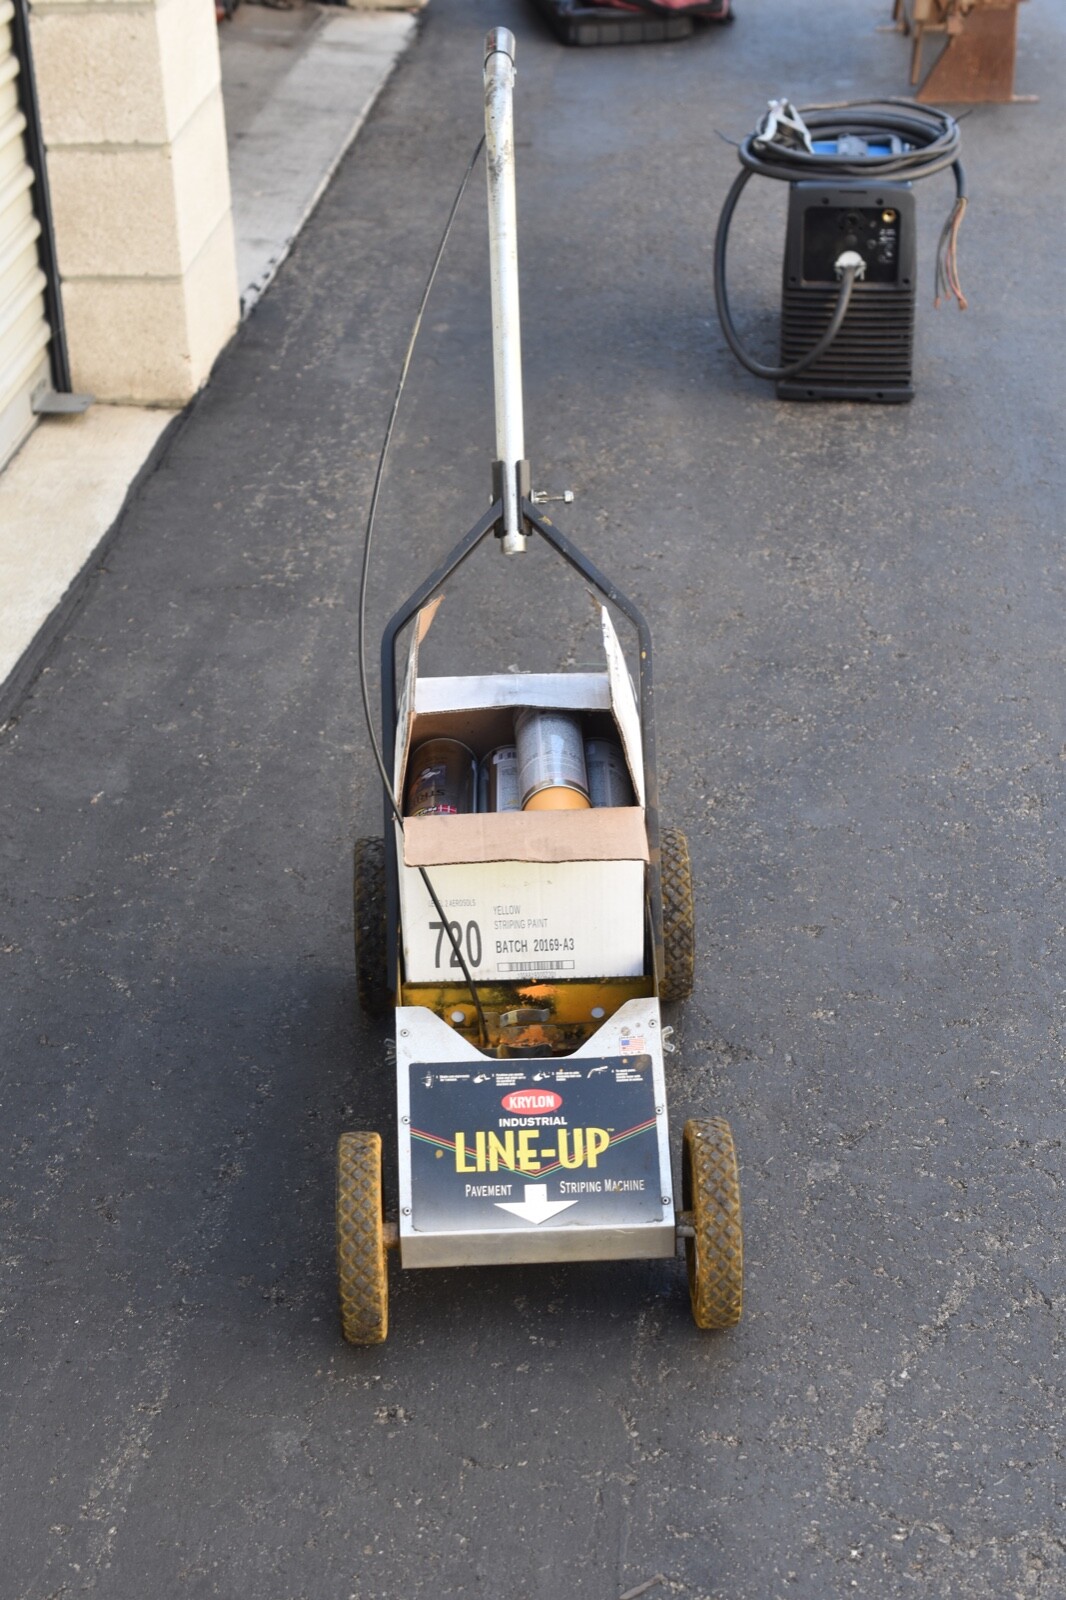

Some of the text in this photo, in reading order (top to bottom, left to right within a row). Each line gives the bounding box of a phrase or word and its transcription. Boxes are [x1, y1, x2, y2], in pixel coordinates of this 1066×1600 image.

[493, 905, 521, 916] YELLOW
[494, 918, 548, 930] STRIPING PAINT
[428, 920, 482, 969] 720
[495, 937, 575, 954] BATCH 20169-A3
[509, 1095, 555, 1109] KRYLON
[498, 1116, 568, 1128] INDUSTRIAL
[454, 1127, 611, 1173] LINE-UP
[465, 1178, 645, 1198] PAVEMENT STRIPING MACHINE
